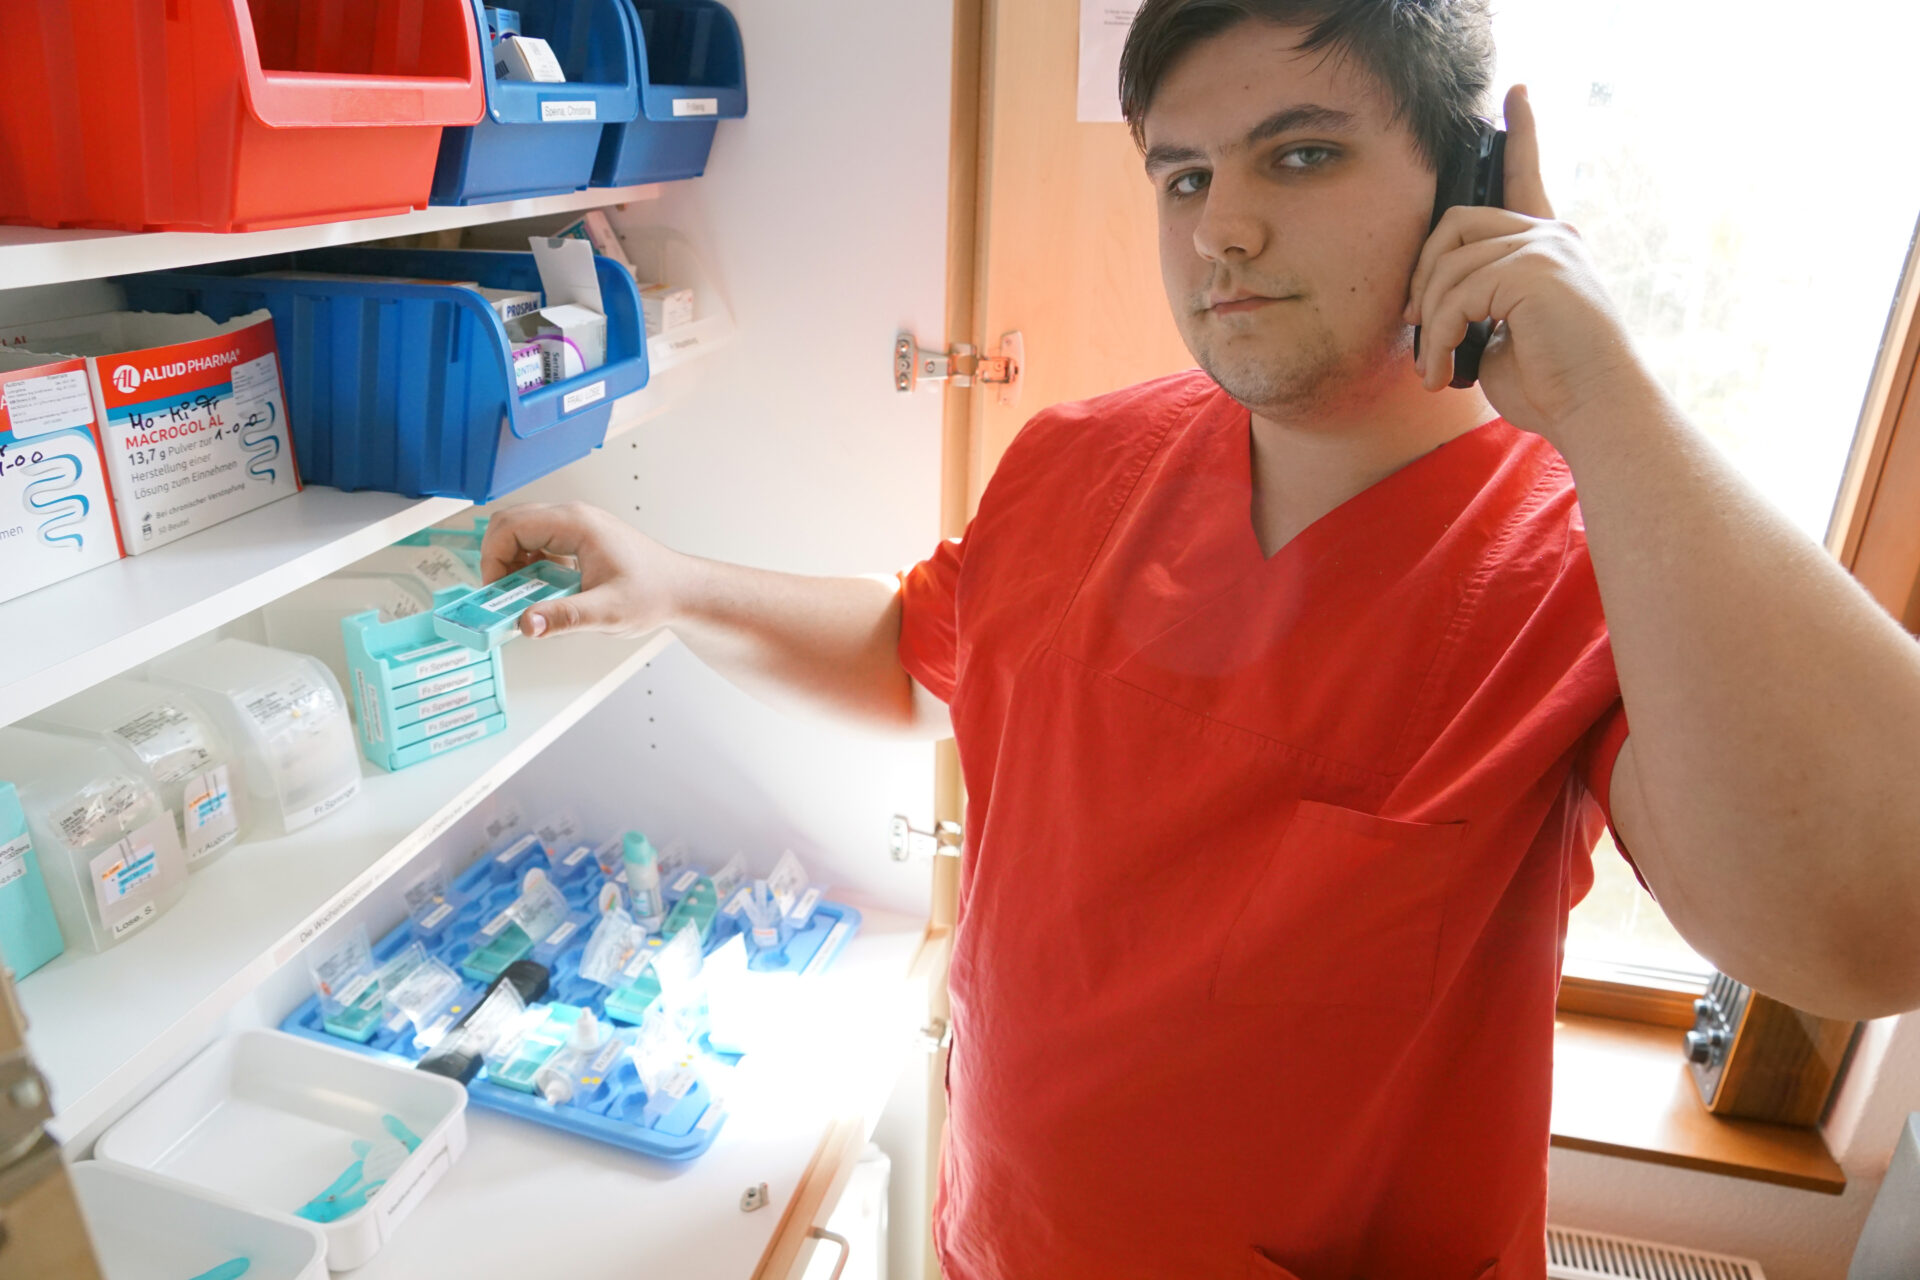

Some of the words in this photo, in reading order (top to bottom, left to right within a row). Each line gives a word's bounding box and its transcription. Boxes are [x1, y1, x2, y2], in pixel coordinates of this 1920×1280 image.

[506, 300, 538, 318] PROSPAN
[143, 362, 187, 382] ALIUD
[125, 420, 206, 450] MACROGOL
[208, 414, 224, 429] AL
[128, 448, 156, 466] 13,7
[159, 451, 167, 461] g
[168, 440, 197, 456] Pulver
[199, 437, 212, 448] zur
[131, 460, 188, 483] Herstellung
[189, 453, 212, 467] einer
[134, 482, 170, 500] Lösung
[171, 475, 191, 489] zum
[191, 460, 239, 482] Einnehmen
[156, 510, 168, 519] Bei
[169, 496, 207, 515] chronischer
[207, 483, 246, 501] Verstopfung
